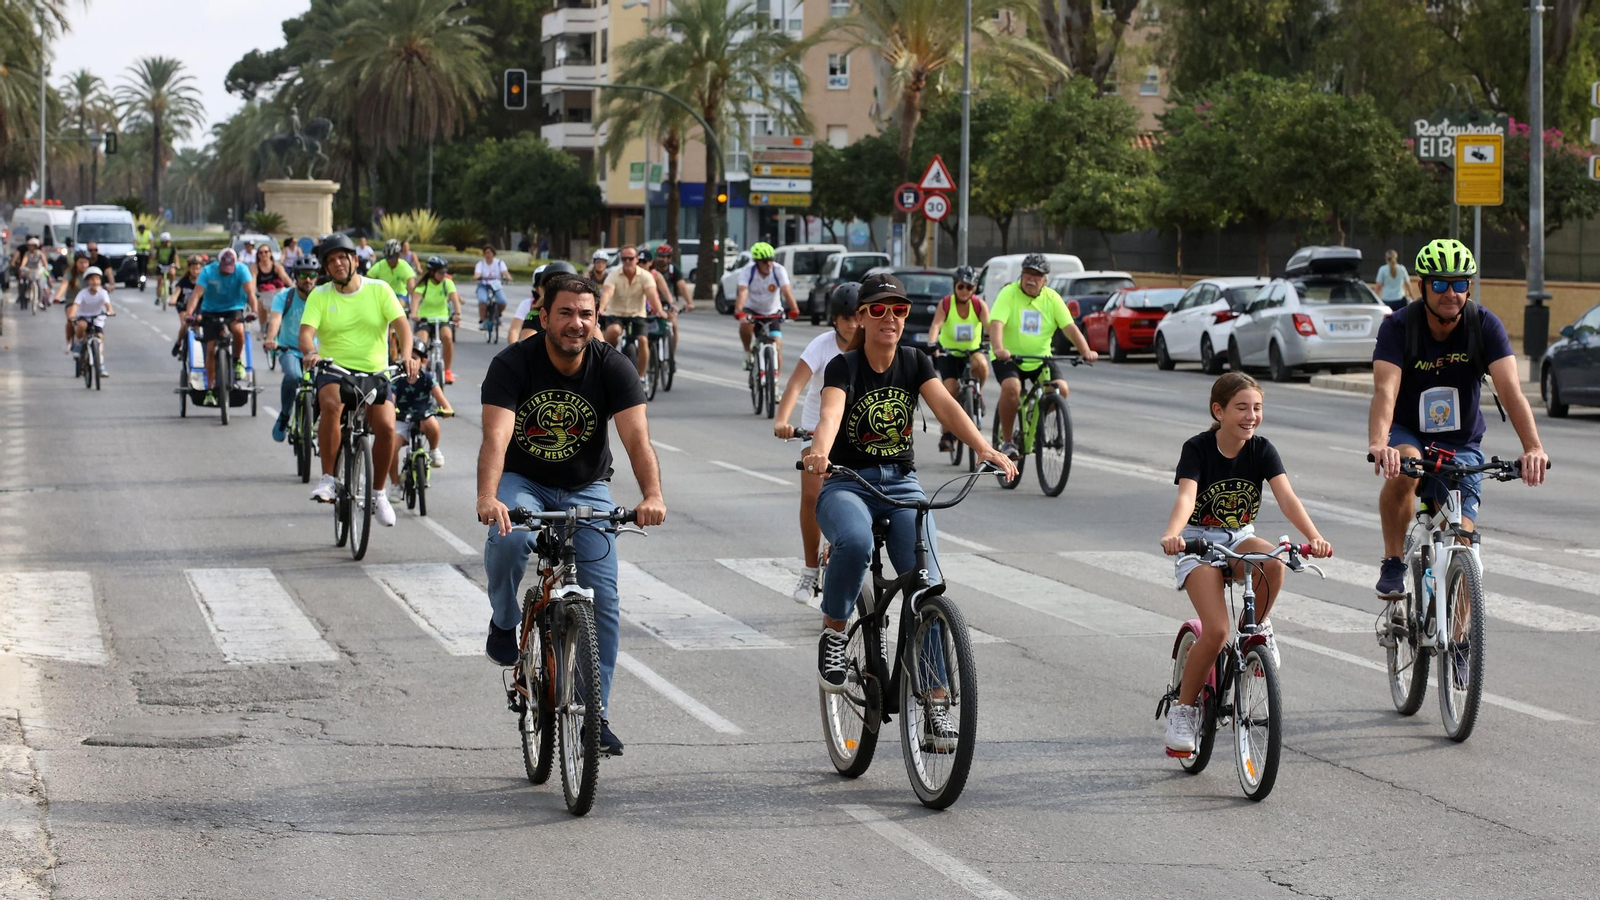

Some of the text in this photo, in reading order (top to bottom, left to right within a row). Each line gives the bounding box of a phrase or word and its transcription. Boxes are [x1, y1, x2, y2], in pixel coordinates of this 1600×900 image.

[1414, 118, 1504, 136] Restaurante
[1420, 137, 1456, 157] El B
[928, 202, 944, 212] 30
[856, 392, 879, 413] FIRST
[514, 410, 527, 441] STRIKE
[526, 392, 553, 411] FIRST
[564, 393, 593, 418] STRIKE
[580, 420, 595, 442] HARD
[528, 445, 575, 460] NO MERCY
[865, 444, 877, 456] NO
[1202, 483, 1226, 502] FIRST
[879, 627, 888, 663] JAMIS
